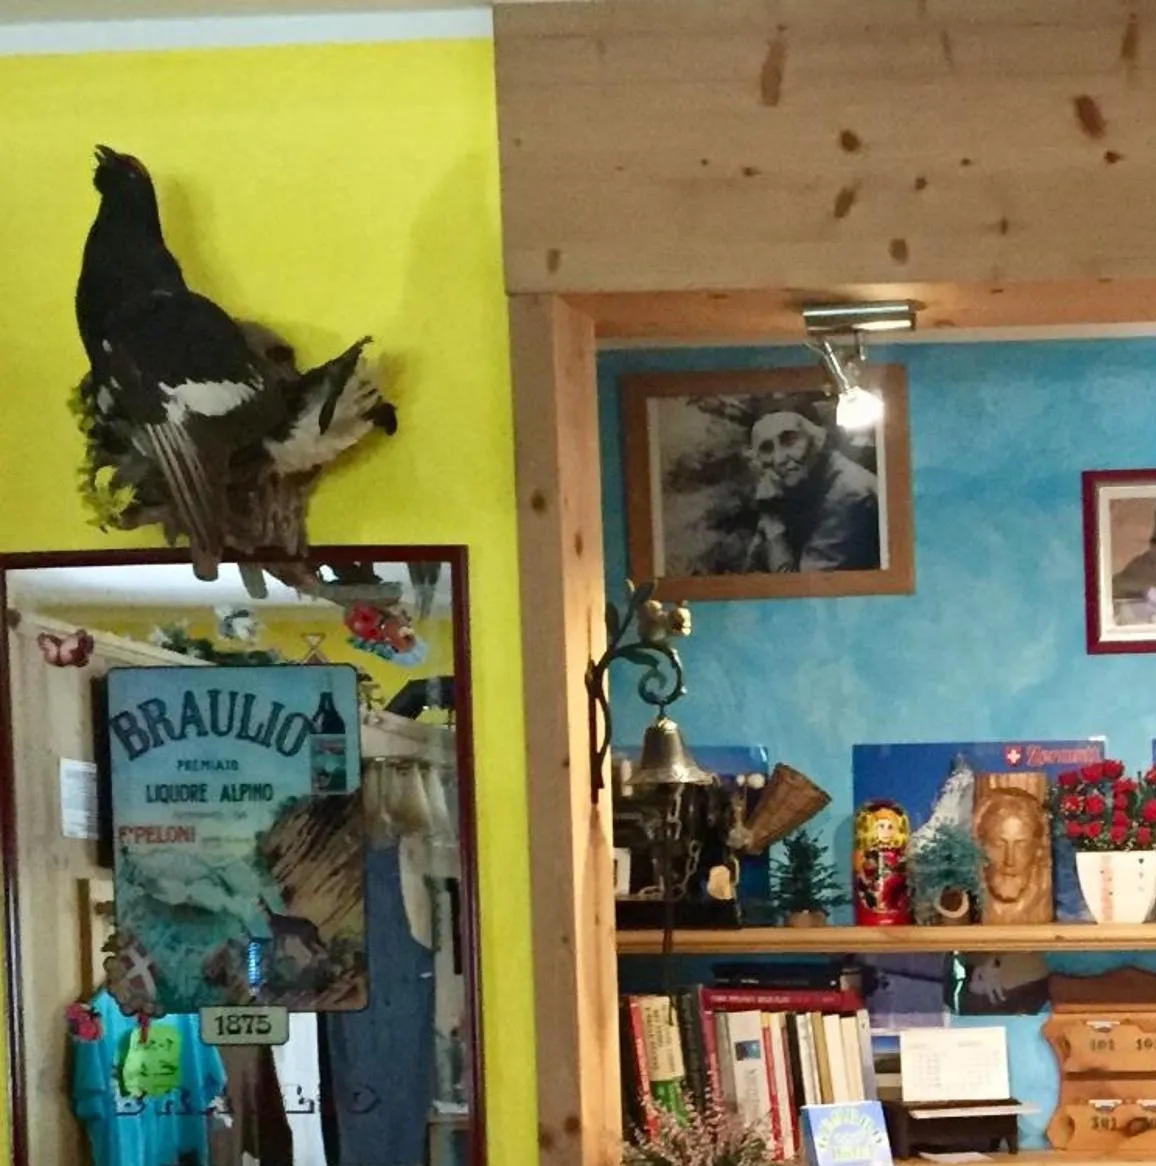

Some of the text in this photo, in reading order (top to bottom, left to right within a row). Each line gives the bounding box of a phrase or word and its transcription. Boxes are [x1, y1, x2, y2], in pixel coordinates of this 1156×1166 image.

[109, 689, 316, 761] BRAULIO
[146, 783, 274, 804] LIQUORE ALPINO
[215, 1014, 272, 1036] 1875
[1090, 1039, 1115, 1050] 101
